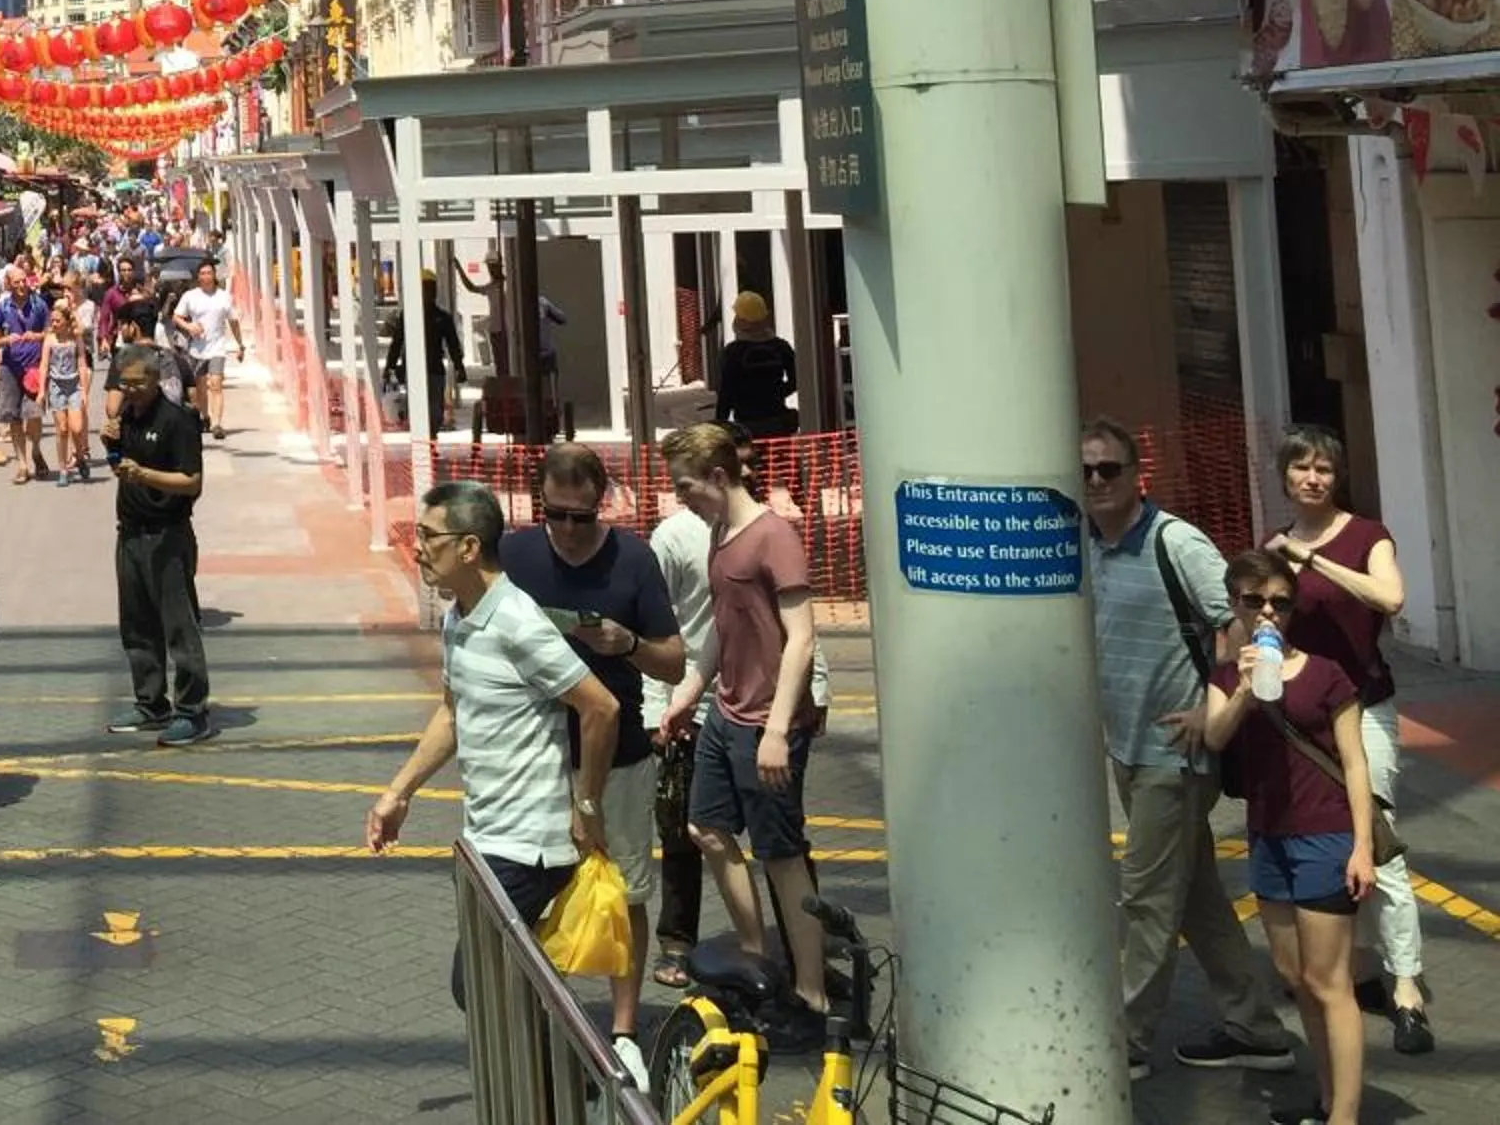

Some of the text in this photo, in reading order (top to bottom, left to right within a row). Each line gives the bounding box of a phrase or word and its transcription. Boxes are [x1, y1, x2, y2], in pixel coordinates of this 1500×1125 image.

[904, 483, 933, 501] This
[937, 486, 1008, 504] Entrance
[1011, 486, 1024, 504] is
[904, 512, 981, 531] accessible
[985, 517, 1001, 532] to
[1005, 515, 1032, 532] the
[906, 538, 954, 558] Please
[957, 545, 986, 559] use
[989, 544, 1054, 560] Entrance
[1055, 541, 1065, 558] C
[907, 564, 927, 583] lift
[931, 571, 980, 586] access
[984, 573, 1001, 588] to
[1005, 572, 1032, 588] the
